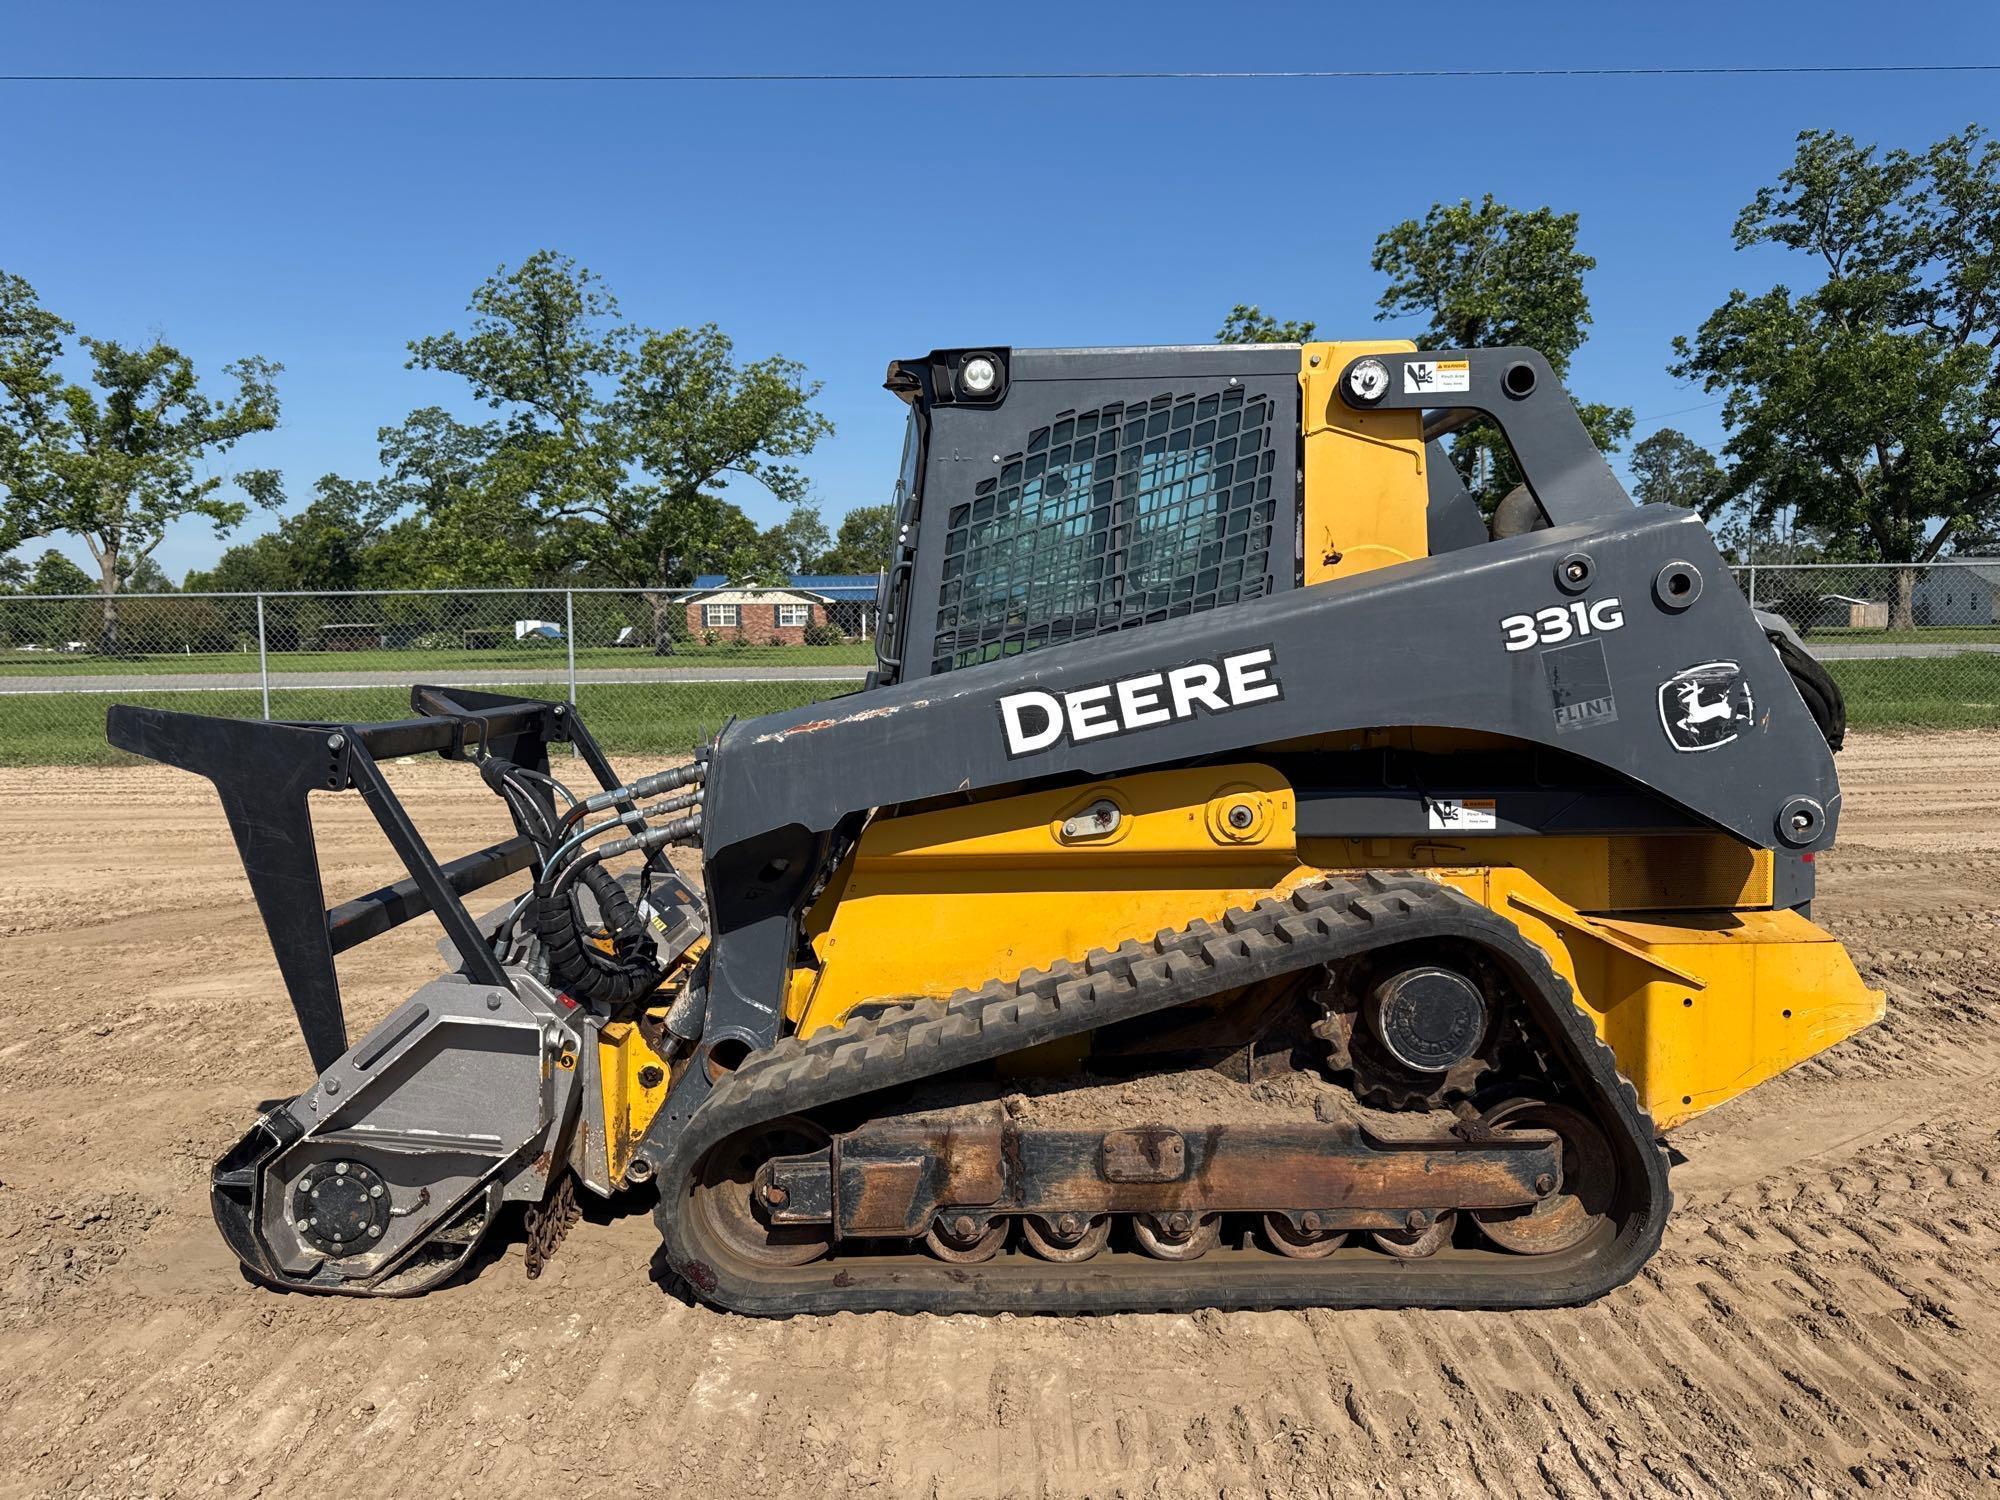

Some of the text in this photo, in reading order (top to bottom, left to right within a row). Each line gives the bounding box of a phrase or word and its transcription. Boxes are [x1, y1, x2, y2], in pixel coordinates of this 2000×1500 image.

[1501, 598, 1624, 651] 331G
[1000, 649, 1279, 755] DEERE
[1554, 697, 1612, 723] FLINT
